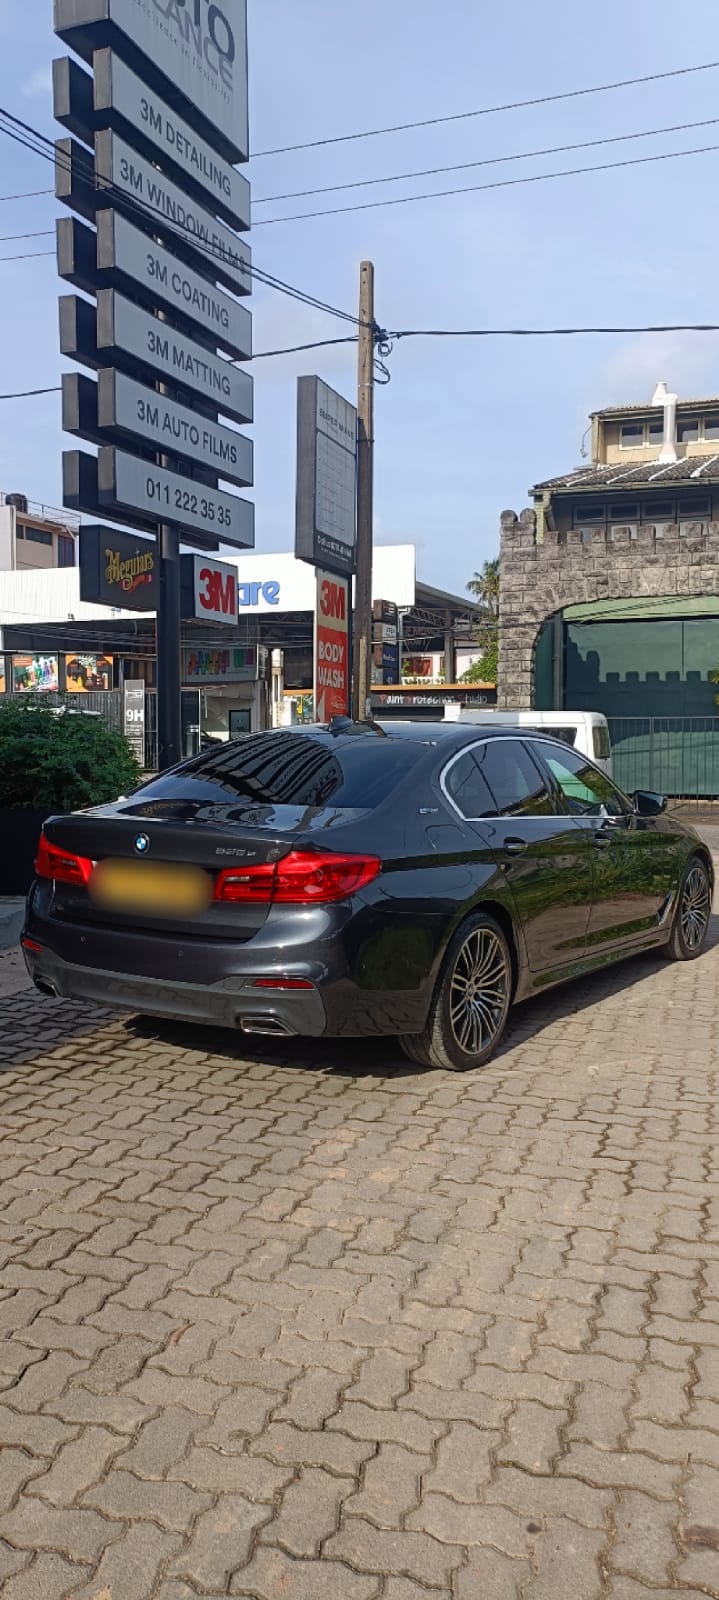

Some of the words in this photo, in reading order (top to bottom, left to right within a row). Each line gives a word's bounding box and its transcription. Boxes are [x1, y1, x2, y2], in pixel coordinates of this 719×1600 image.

[139, 97, 162, 136] 3M
[165, 127, 232, 197] DETAILING
[119, 158, 143, 193] 3M
[147, 178, 209, 247] WINDOW
[211, 233, 246, 276] FILMS
[146, 254, 168, 286] 3M
[171, 270, 229, 329] COATING
[147, 331, 169, 361] 3M
[172, 346, 231, 396] MATTING
[137, 399, 159, 428] 3M
[161, 411, 199, 446] AUTO
[202, 431, 238, 464] FILMS
[146, 478, 169, 502] 011
[175, 489, 198, 514] 222
[200, 498, 215, 521] 35
[217, 504, 232, 527] 35
[199, 568, 235, 616] 3M
[320, 580, 345, 621] 3M
[318, 640, 344, 664] BODY
[318, 666, 344, 690] WASH
[380, 694, 404, 705] Paint
[407, 693, 456, 705] Protection
[458, 692, 488, 704] Studio
[126, 709, 144, 722] 9H
